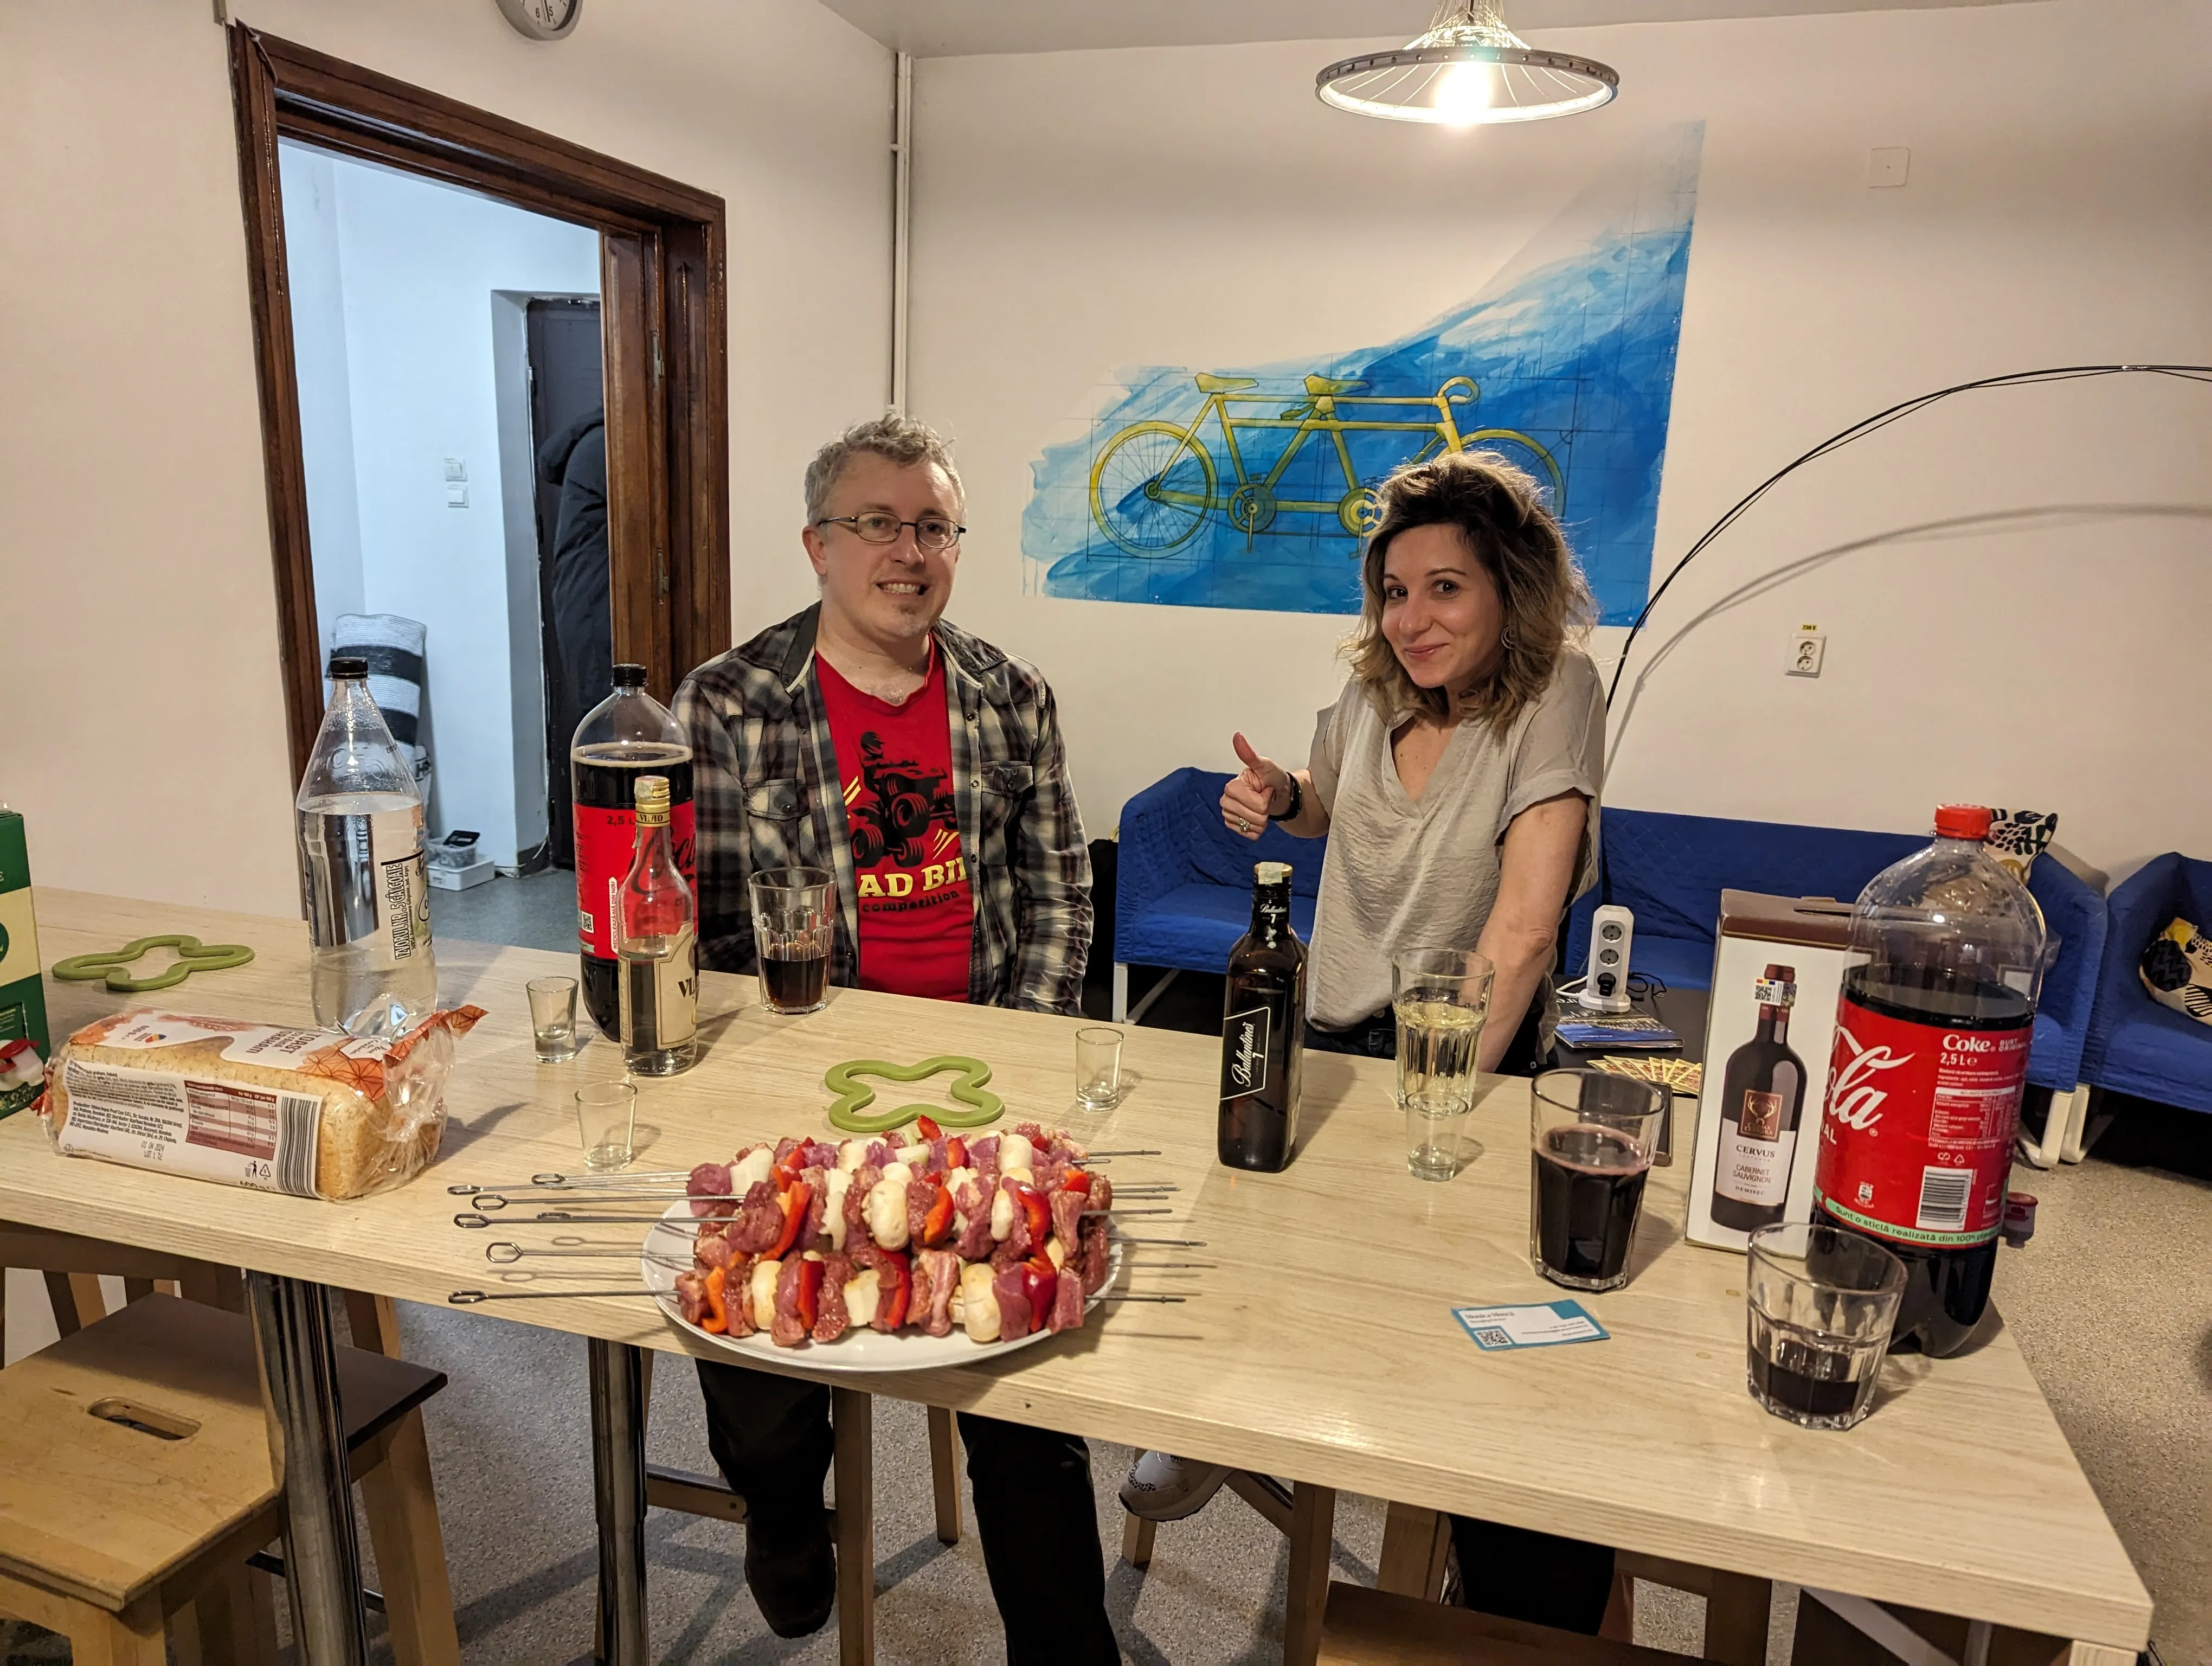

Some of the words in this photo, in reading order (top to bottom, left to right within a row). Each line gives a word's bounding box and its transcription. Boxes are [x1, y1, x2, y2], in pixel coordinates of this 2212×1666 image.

[535, 8, 540, 18] 6
[549, 6, 554, 16] 5
[606, 815, 625, 826] 2,5
[639, 814, 664, 822] VLAD
[385, 863, 405, 904] GÂLGOAIE
[858, 873, 914, 898] AD
[861, 888, 960, 913] competition
[1270, 913, 1276, 924] 7
[392, 924, 411, 960] IZVORUL
[677, 977, 696, 998] VL
[246, 1031, 292, 1054] GRAHAM
[278, 1033, 321, 1054] TOAST
[1942, 1033, 1991, 1053] Coke
[1231, 1021, 1255, 1087] Ballantine's
[1940, 1052, 1957, 1066] 2,5
[1959, 1055, 1966, 1067] L
[1822, 1124, 1837, 1145] AL
[1736, 1144, 1776, 1158] CERVUS
[1732, 1170, 1772, 1184] SAUVIGNON
[1735, 1163, 1771, 1176] CABERNET
[1735, 1186, 1765, 1196] DEMISEC
[1836, 1205, 1854, 1220] Sunt
[1863, 1219, 1889, 1233] sticlă
[1892, 1227, 1937, 1241] realizată
[1939, 1233, 1953, 1242] din
